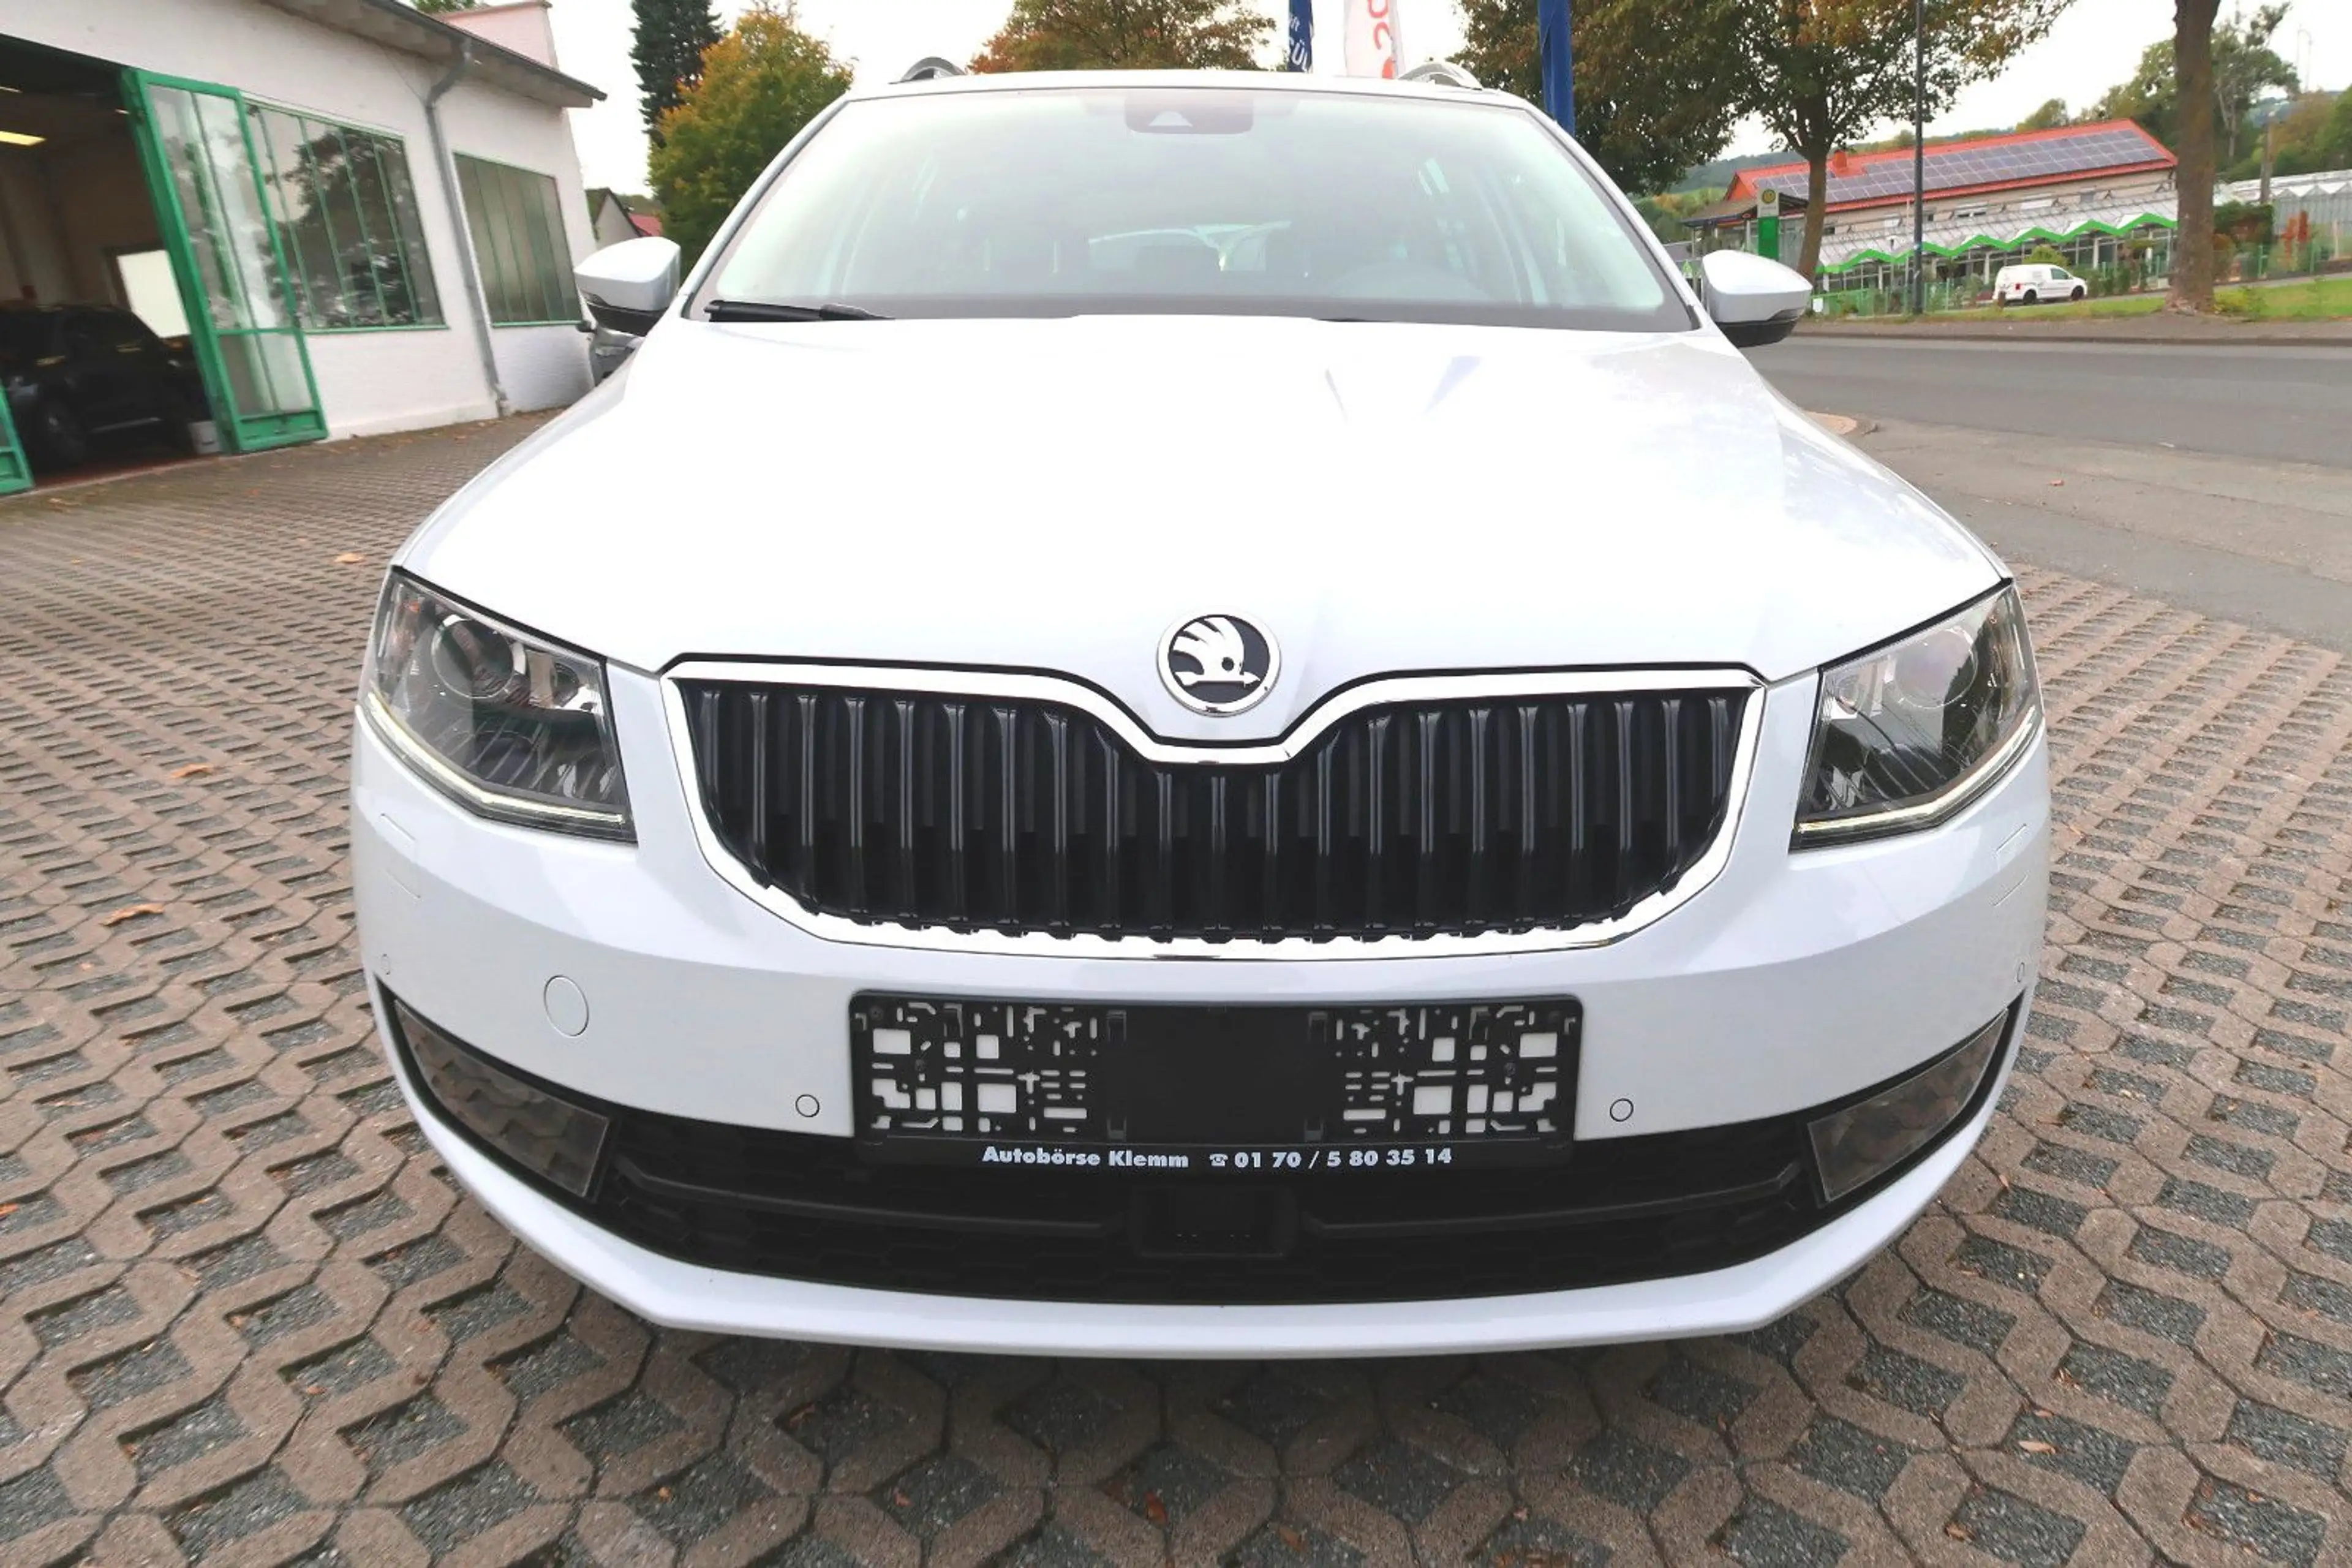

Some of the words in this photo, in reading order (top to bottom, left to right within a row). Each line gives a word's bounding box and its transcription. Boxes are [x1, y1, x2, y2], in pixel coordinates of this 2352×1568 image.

[982, 1146, 1101, 1166] Autobörse
[1108, 1150, 1189, 1168] Klemm
[1234, 1152, 1261, 1168] 01
[1272, 1152, 1302, 1168] 70
[1308, 1150, 1320, 1169] /
[1327, 1150, 1341, 1167] 5
[1349, 1150, 1379, 1166] 80
[1385, 1148, 1415, 1166] 35
[1425, 1147, 1452, 1164] 14
